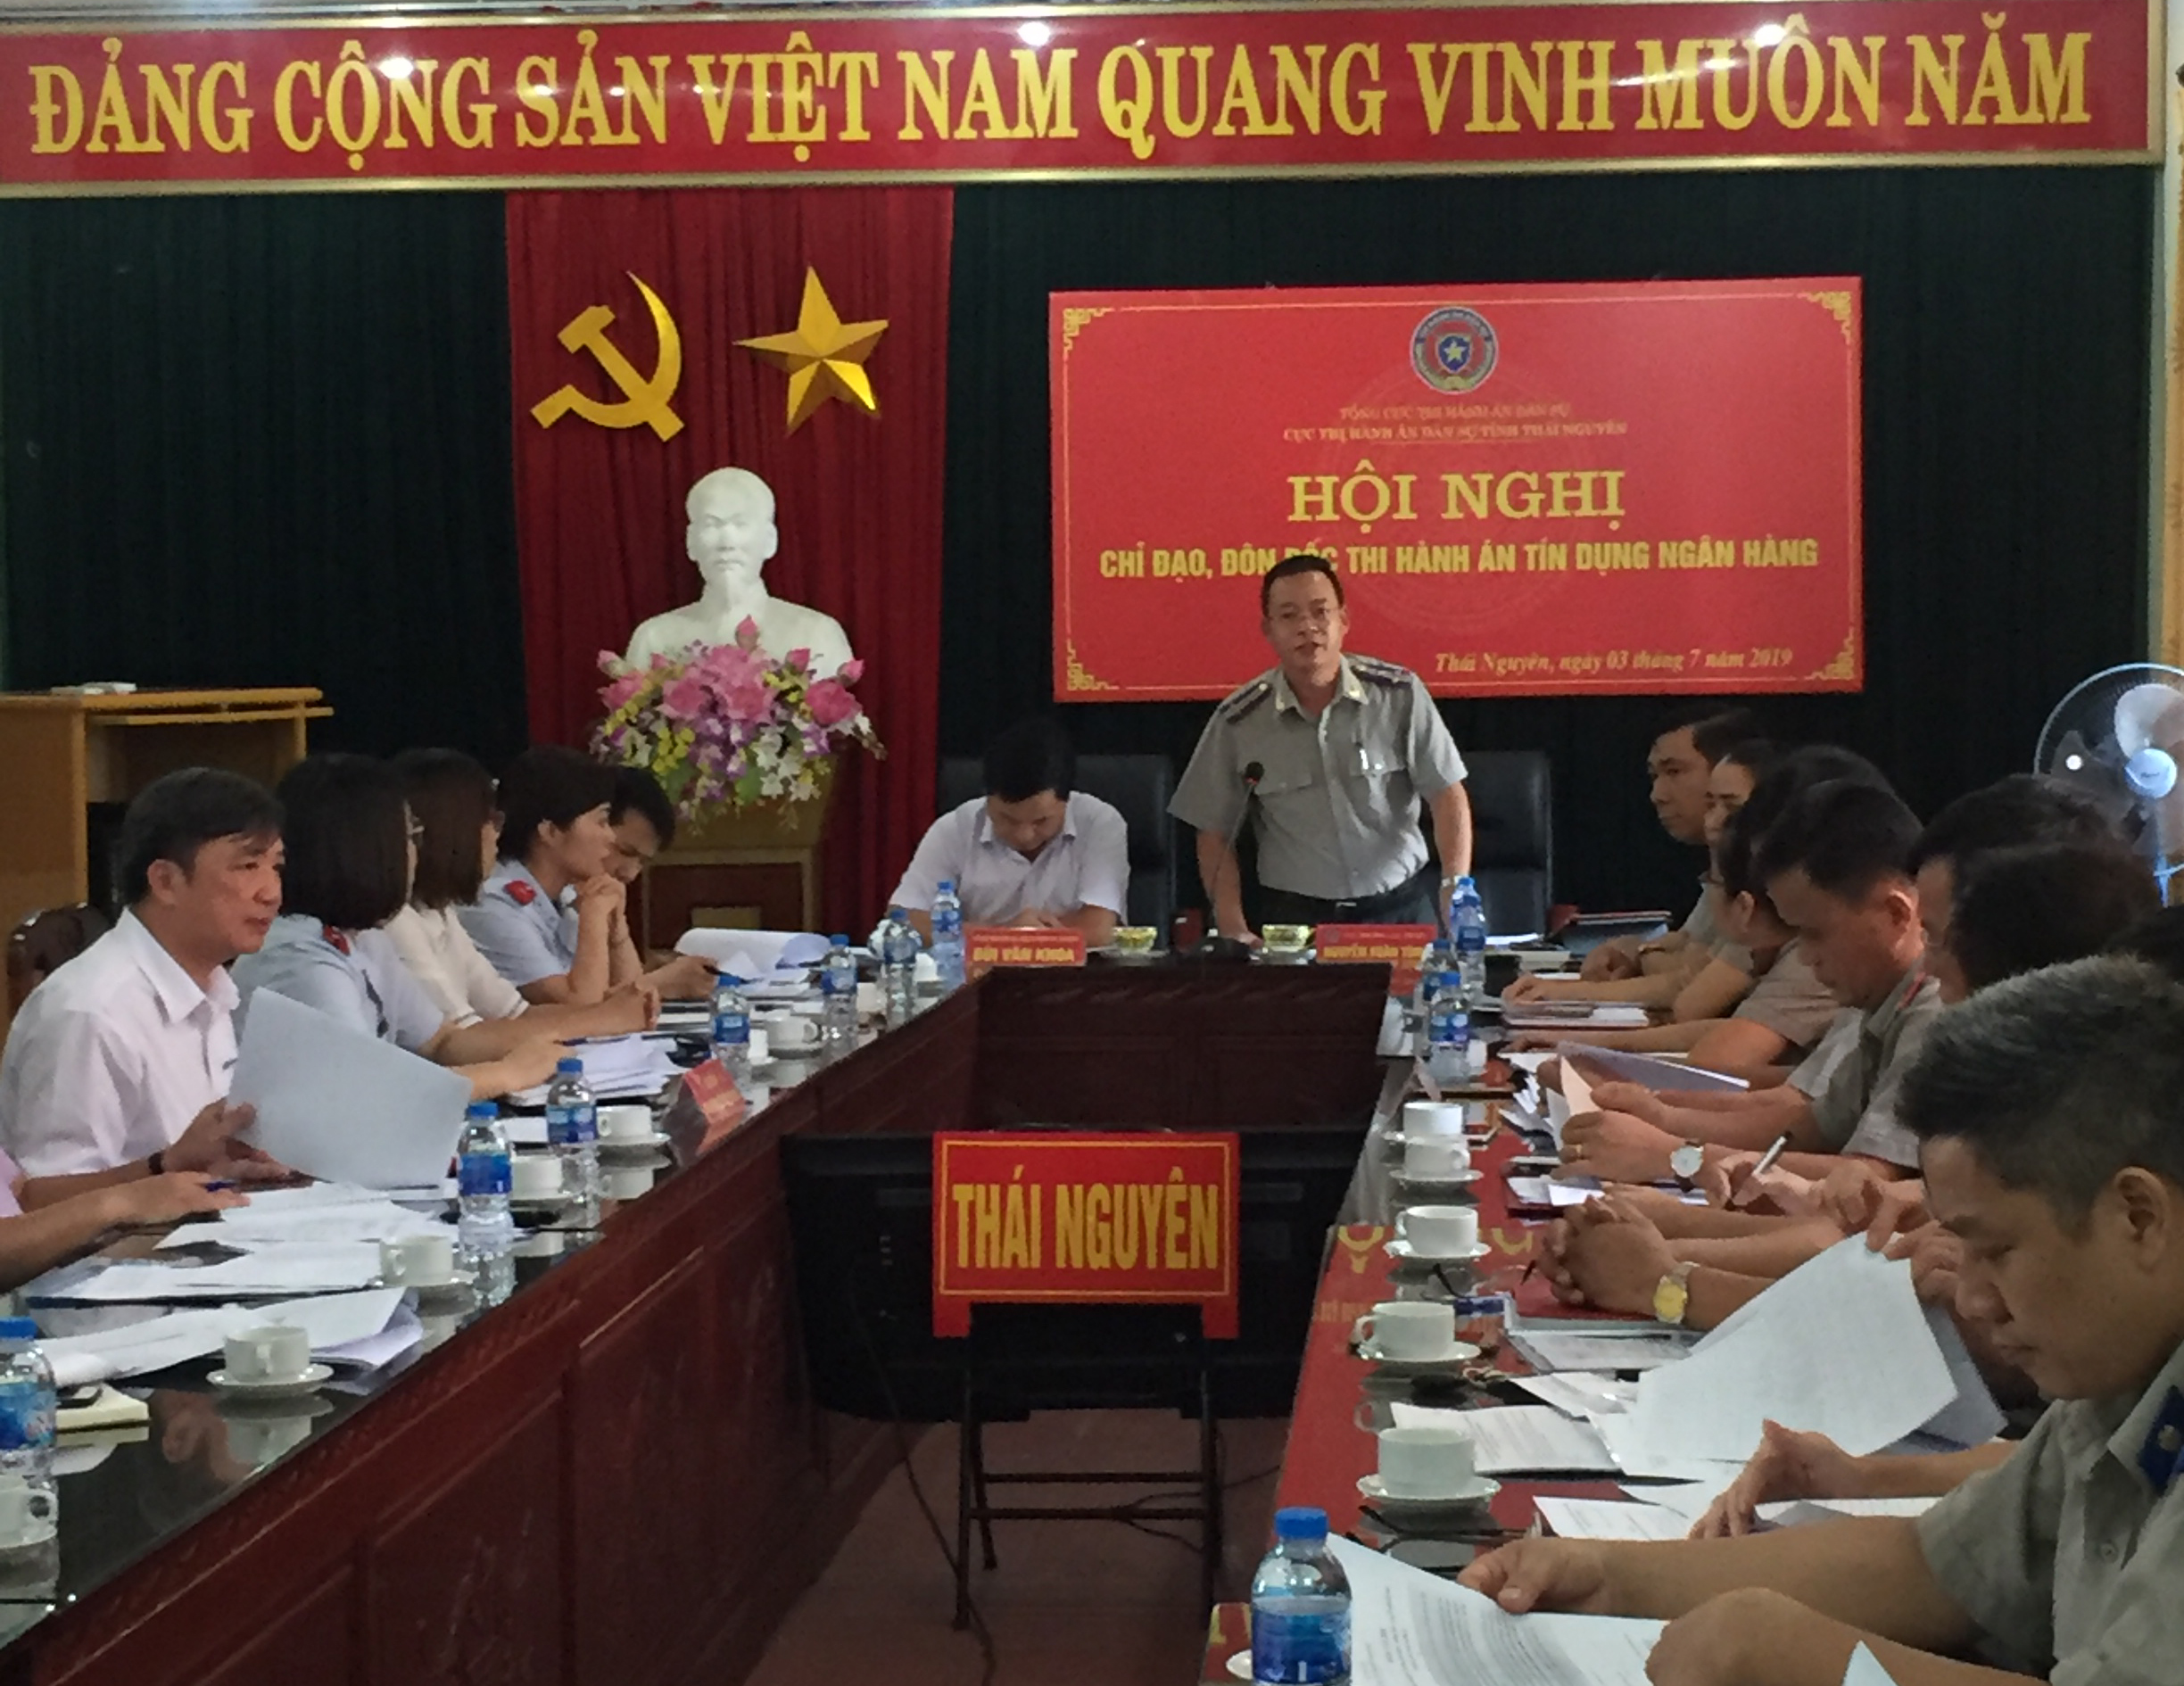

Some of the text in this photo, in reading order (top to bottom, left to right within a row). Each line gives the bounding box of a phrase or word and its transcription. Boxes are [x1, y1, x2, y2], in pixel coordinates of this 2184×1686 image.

[29, 11, 2092, 171] ĐẢNG CỘNG SẢN VIỆT NAM QUANG VINH MUÔN NĂM
[1286, 459, 1626, 534] HỘI NGHỊ
[1099, 541, 1145, 578] CHỈ
[1151, 547, 1214, 583] ĐẠO,
[1220, 542, 1277, 576] ĐÔN
[1346, 546, 1387, 574] THI
[1395, 540, 1470, 574] HÀNH
[1477, 539, 1517, 573] ÁN
[1524, 536, 1568, 571] TÍN
[1576, 541, 1650, 576] DỤNG
[1658, 533, 1735, 570] NGÂN
[1742, 533, 1819, 567] HÀNG
[1435, 647, 1793, 677] Thái Nguyên, ngày 03 tháng 7 năm 2019
[952, 1164, 1219, 1270] THÁI NGUYÊN
